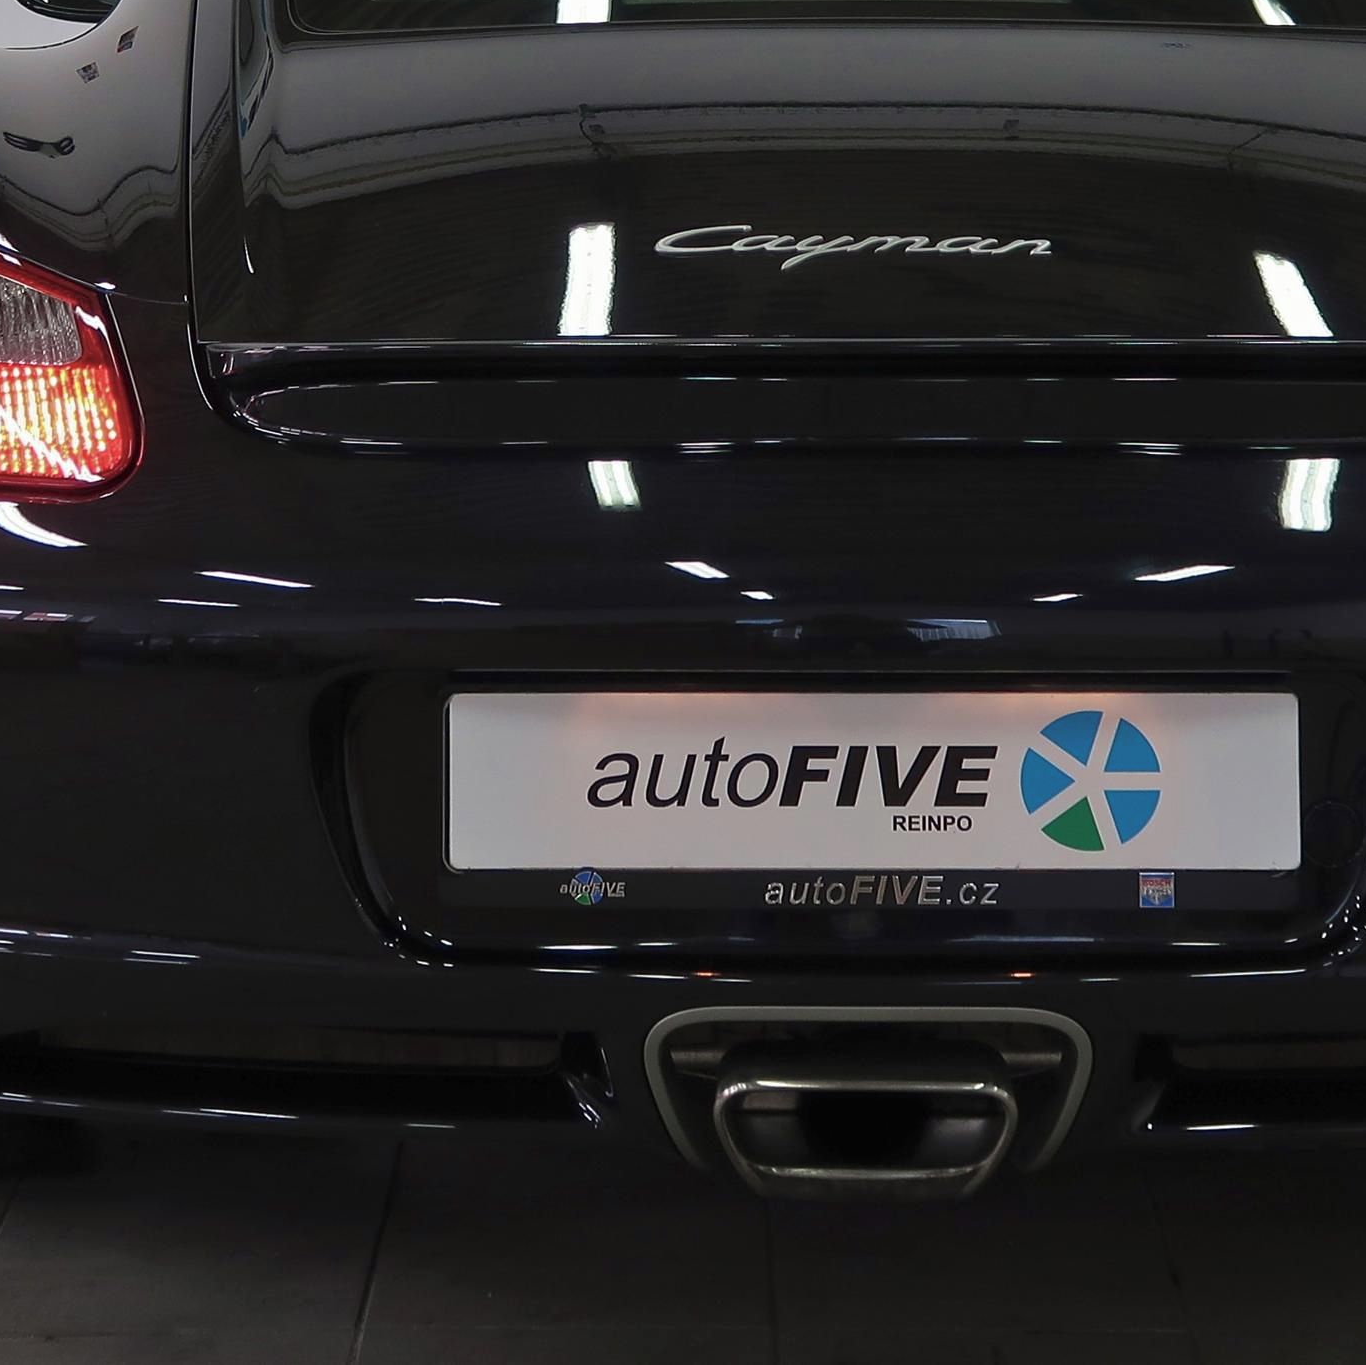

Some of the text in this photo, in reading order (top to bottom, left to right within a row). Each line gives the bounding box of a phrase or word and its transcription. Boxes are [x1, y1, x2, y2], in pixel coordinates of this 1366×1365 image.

[653, 224, 1053, 270] Cayman
[586, 736, 999, 808] autoFIVE
[892, 815, 973, 832] REINPO
[763, 875, 1000, 905] autoFIVE.cz
